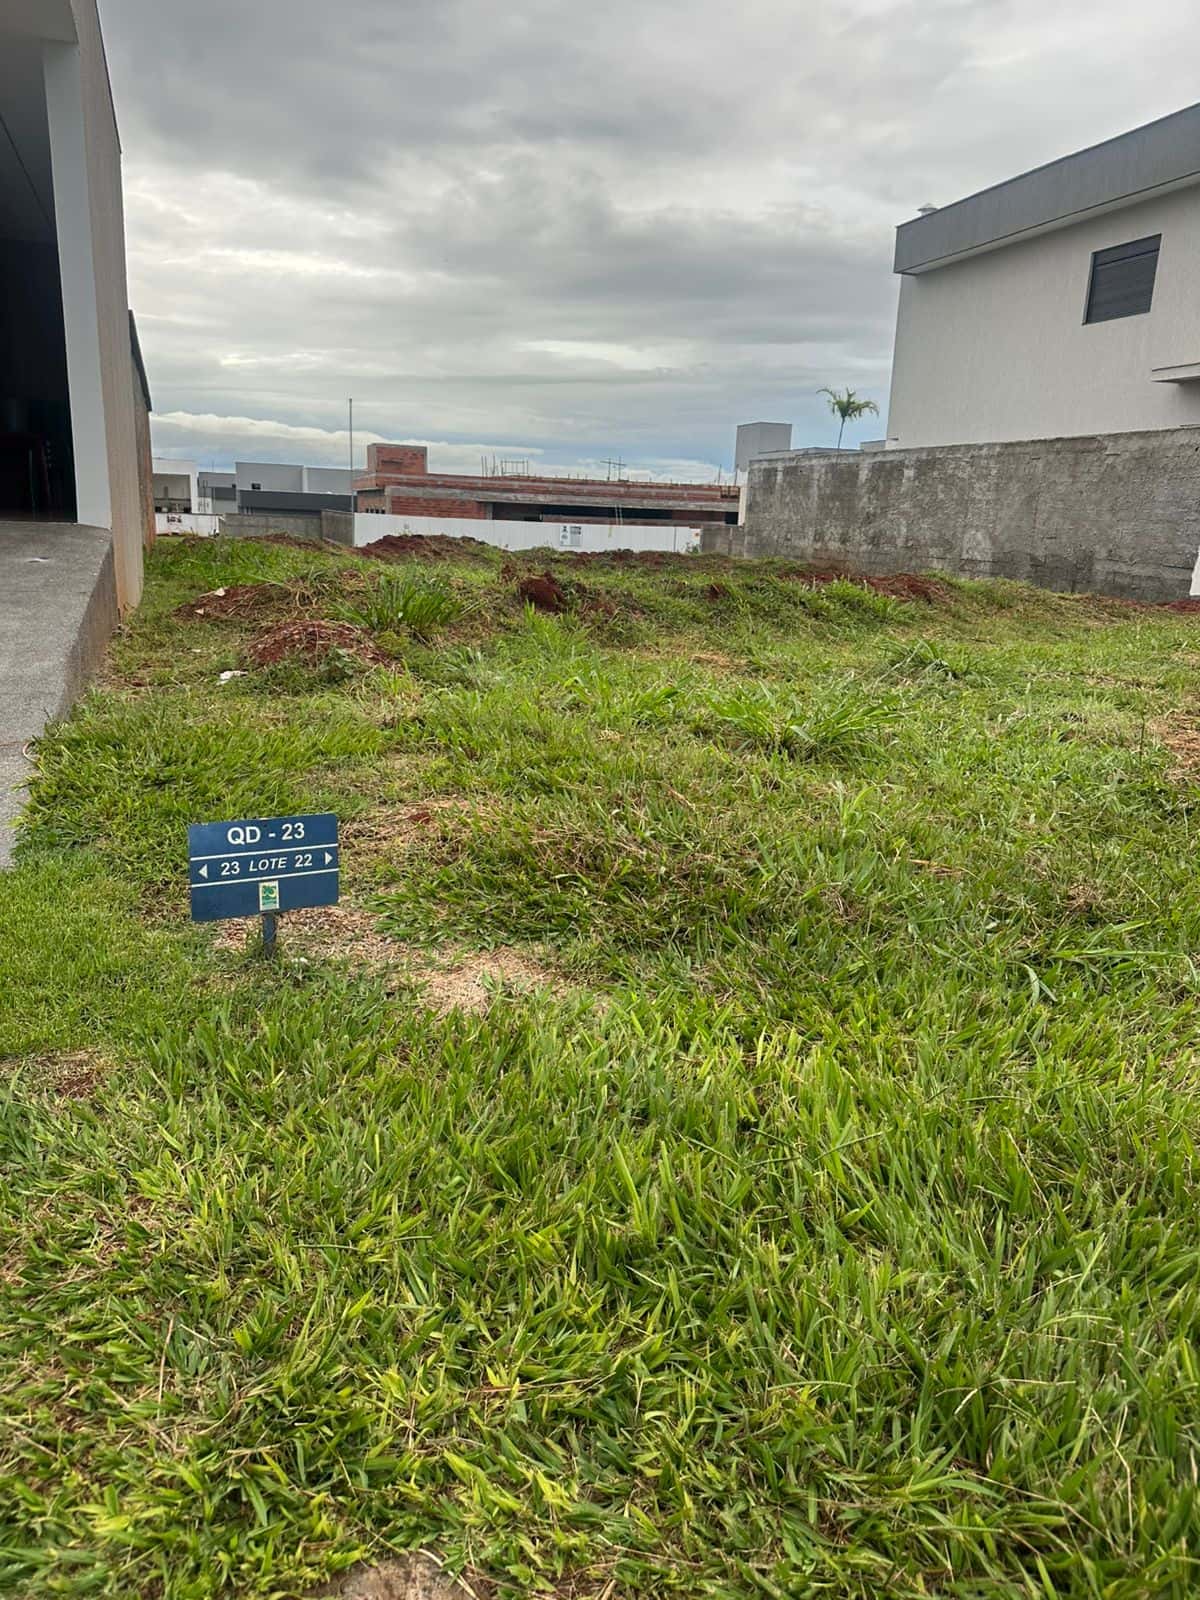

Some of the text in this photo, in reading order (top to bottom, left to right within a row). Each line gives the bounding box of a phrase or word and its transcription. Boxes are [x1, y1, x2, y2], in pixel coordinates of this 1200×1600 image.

[227, 826, 261, 845] QD
[281, 822, 305, 841] 23
[220, 854, 313, 875] 23 LOTE 22
